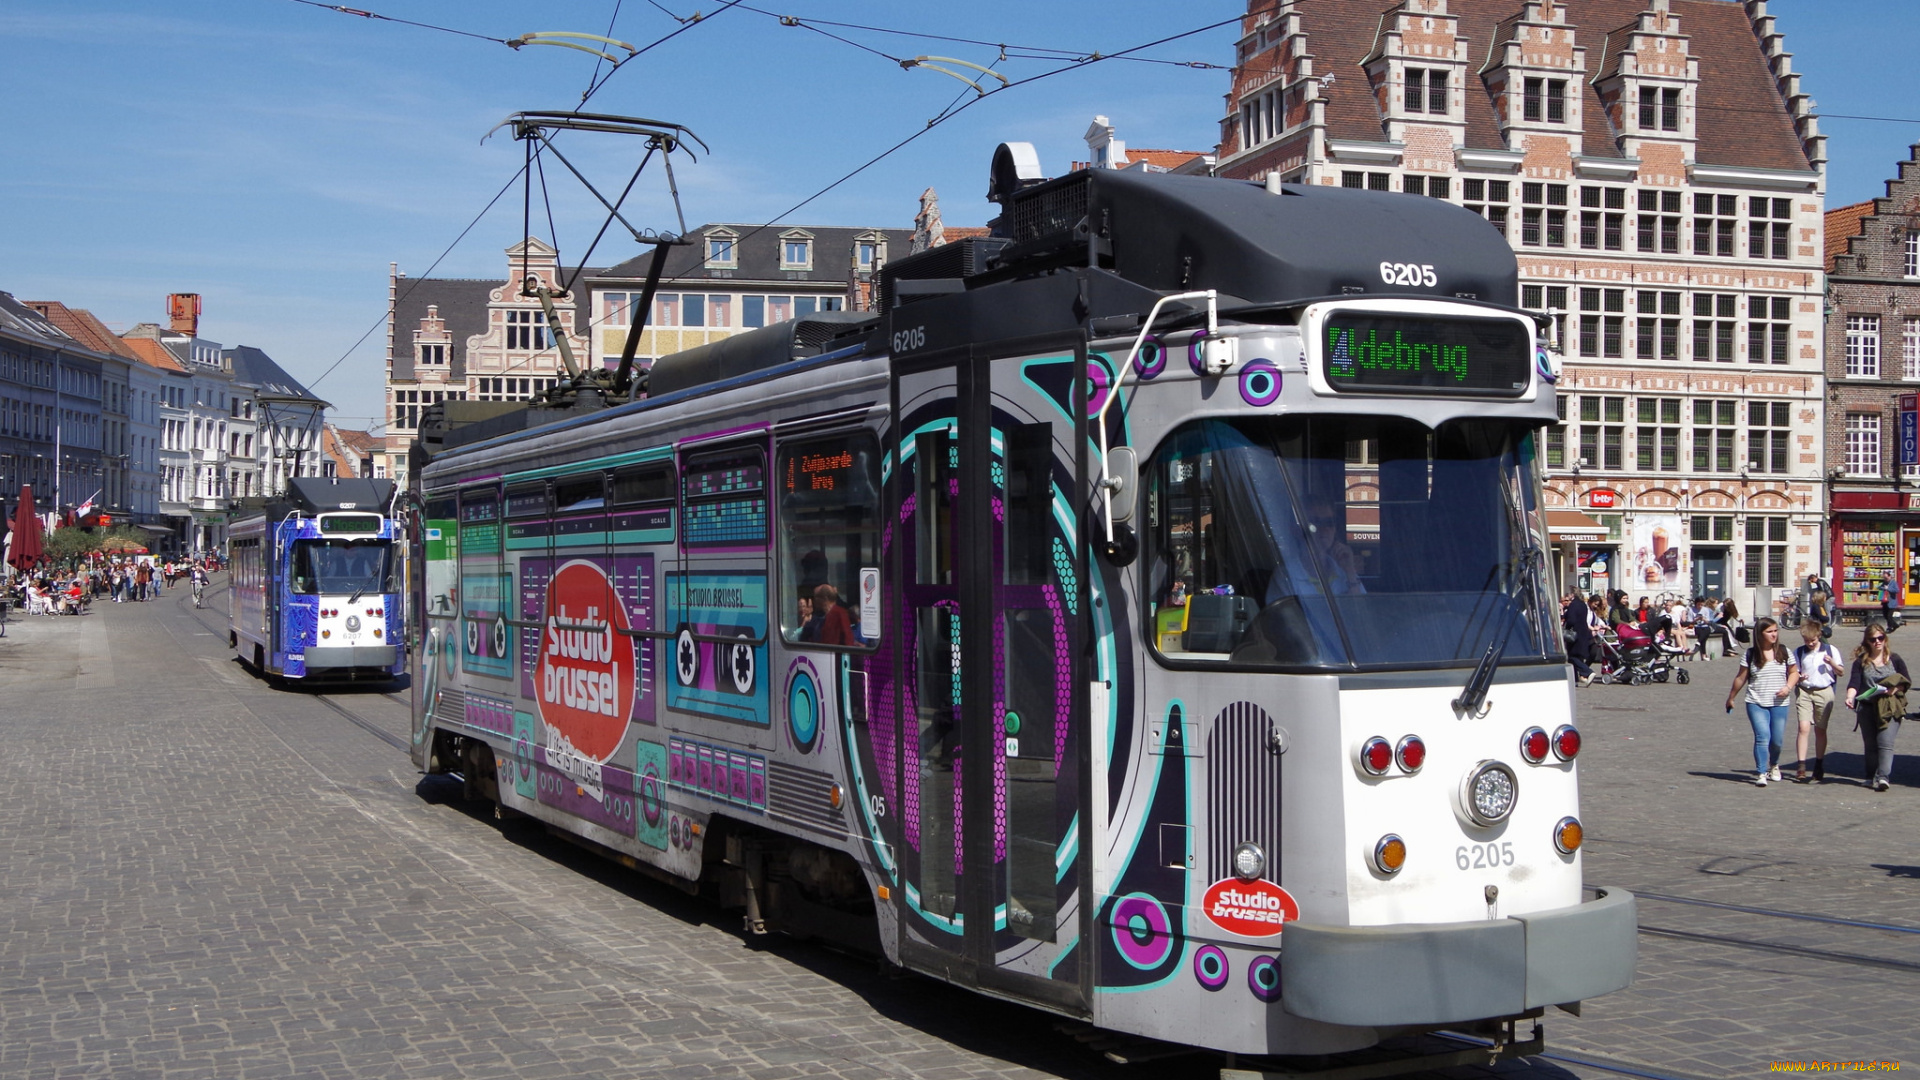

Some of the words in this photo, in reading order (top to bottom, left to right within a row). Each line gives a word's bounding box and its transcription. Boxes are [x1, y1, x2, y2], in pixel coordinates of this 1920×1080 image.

[1380, 262, 1437, 287] 6205
[893, 325, 925, 353] 6205
[1905, 413, 1914, 462] SHOP
[1593, 494, 1613, 504] lotto
[323, 519, 330, 529] 4
[688, 588, 711, 607] STUDIO
[713, 588, 744, 608] BRUSSEL
[548, 604, 613, 665] studio
[543, 652, 619, 718] brussel
[871, 794, 886, 817] 05
[1455, 841, 1515, 871] 6205
[1219, 888, 1281, 911] studio
[1212, 902, 1285, 925] brussel
